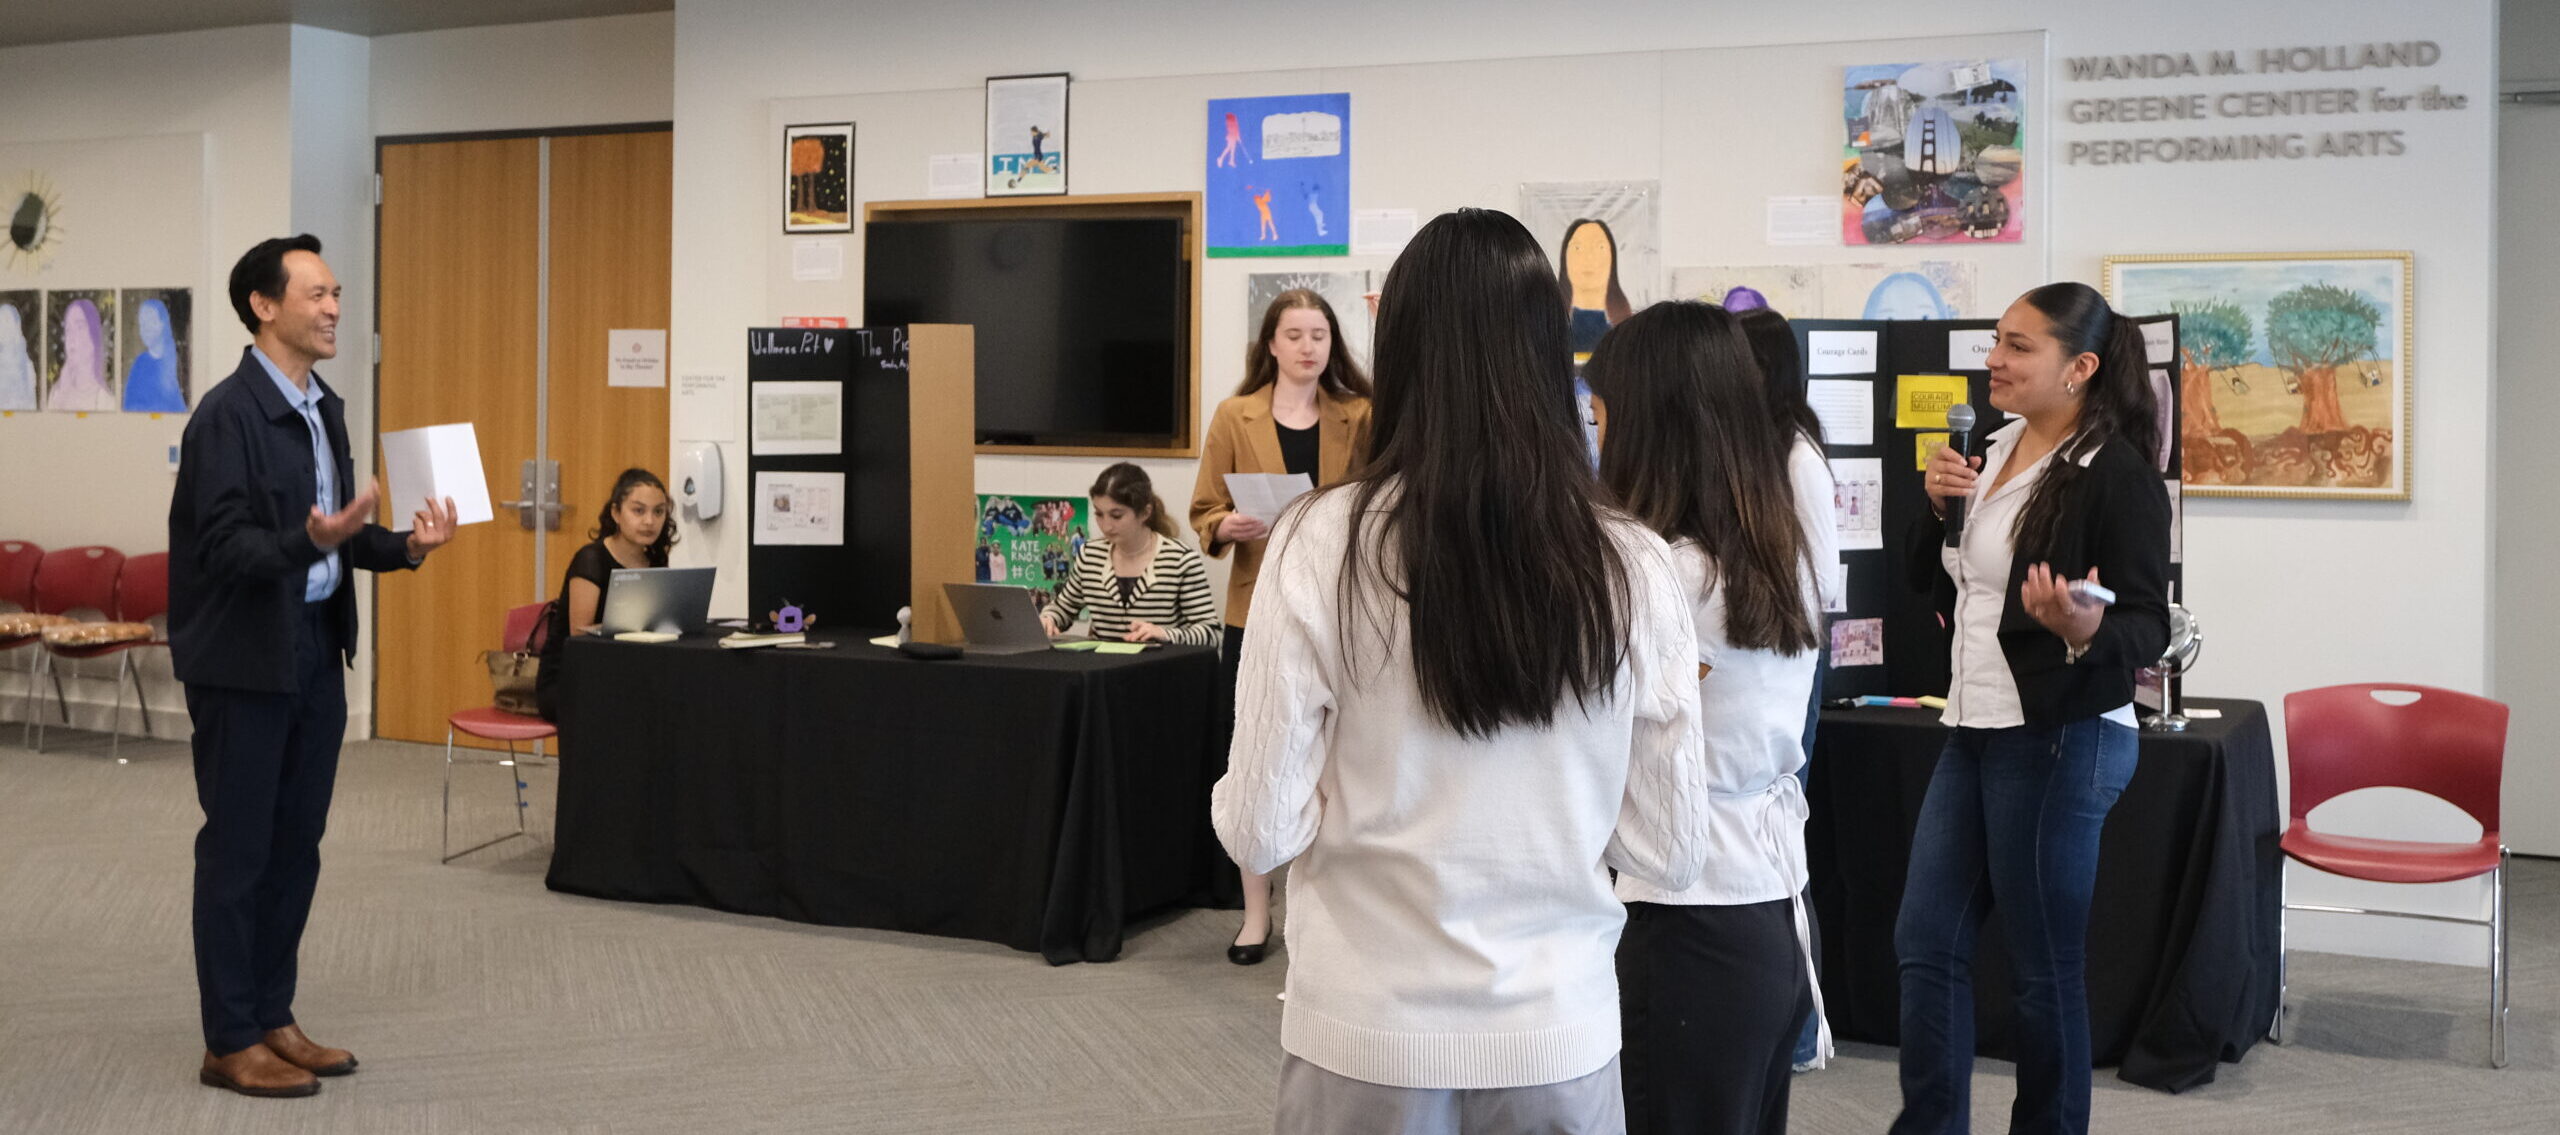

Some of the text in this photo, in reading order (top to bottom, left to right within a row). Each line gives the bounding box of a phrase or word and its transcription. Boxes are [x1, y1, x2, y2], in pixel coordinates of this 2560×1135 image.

[2064, 41, 2441, 81] WANDA M. HOLLAND
[2068, 85, 2468, 124] GREENE CENTER for the
[2068, 130, 2405, 166] PERFORMING ARTS
[856, 330, 882, 357] The
[1972, 344, 1992, 354] Our
[1817, 347, 1868, 357] Courage Cards
[1912, 392, 1952, 401] COURAGE
[1912, 402, 1951, 411] MUSEUM
[1011, 540, 1040, 552] KATE
[1011, 552, 1040, 562] KNOX
[1012, 564, 1035, 581] #6
